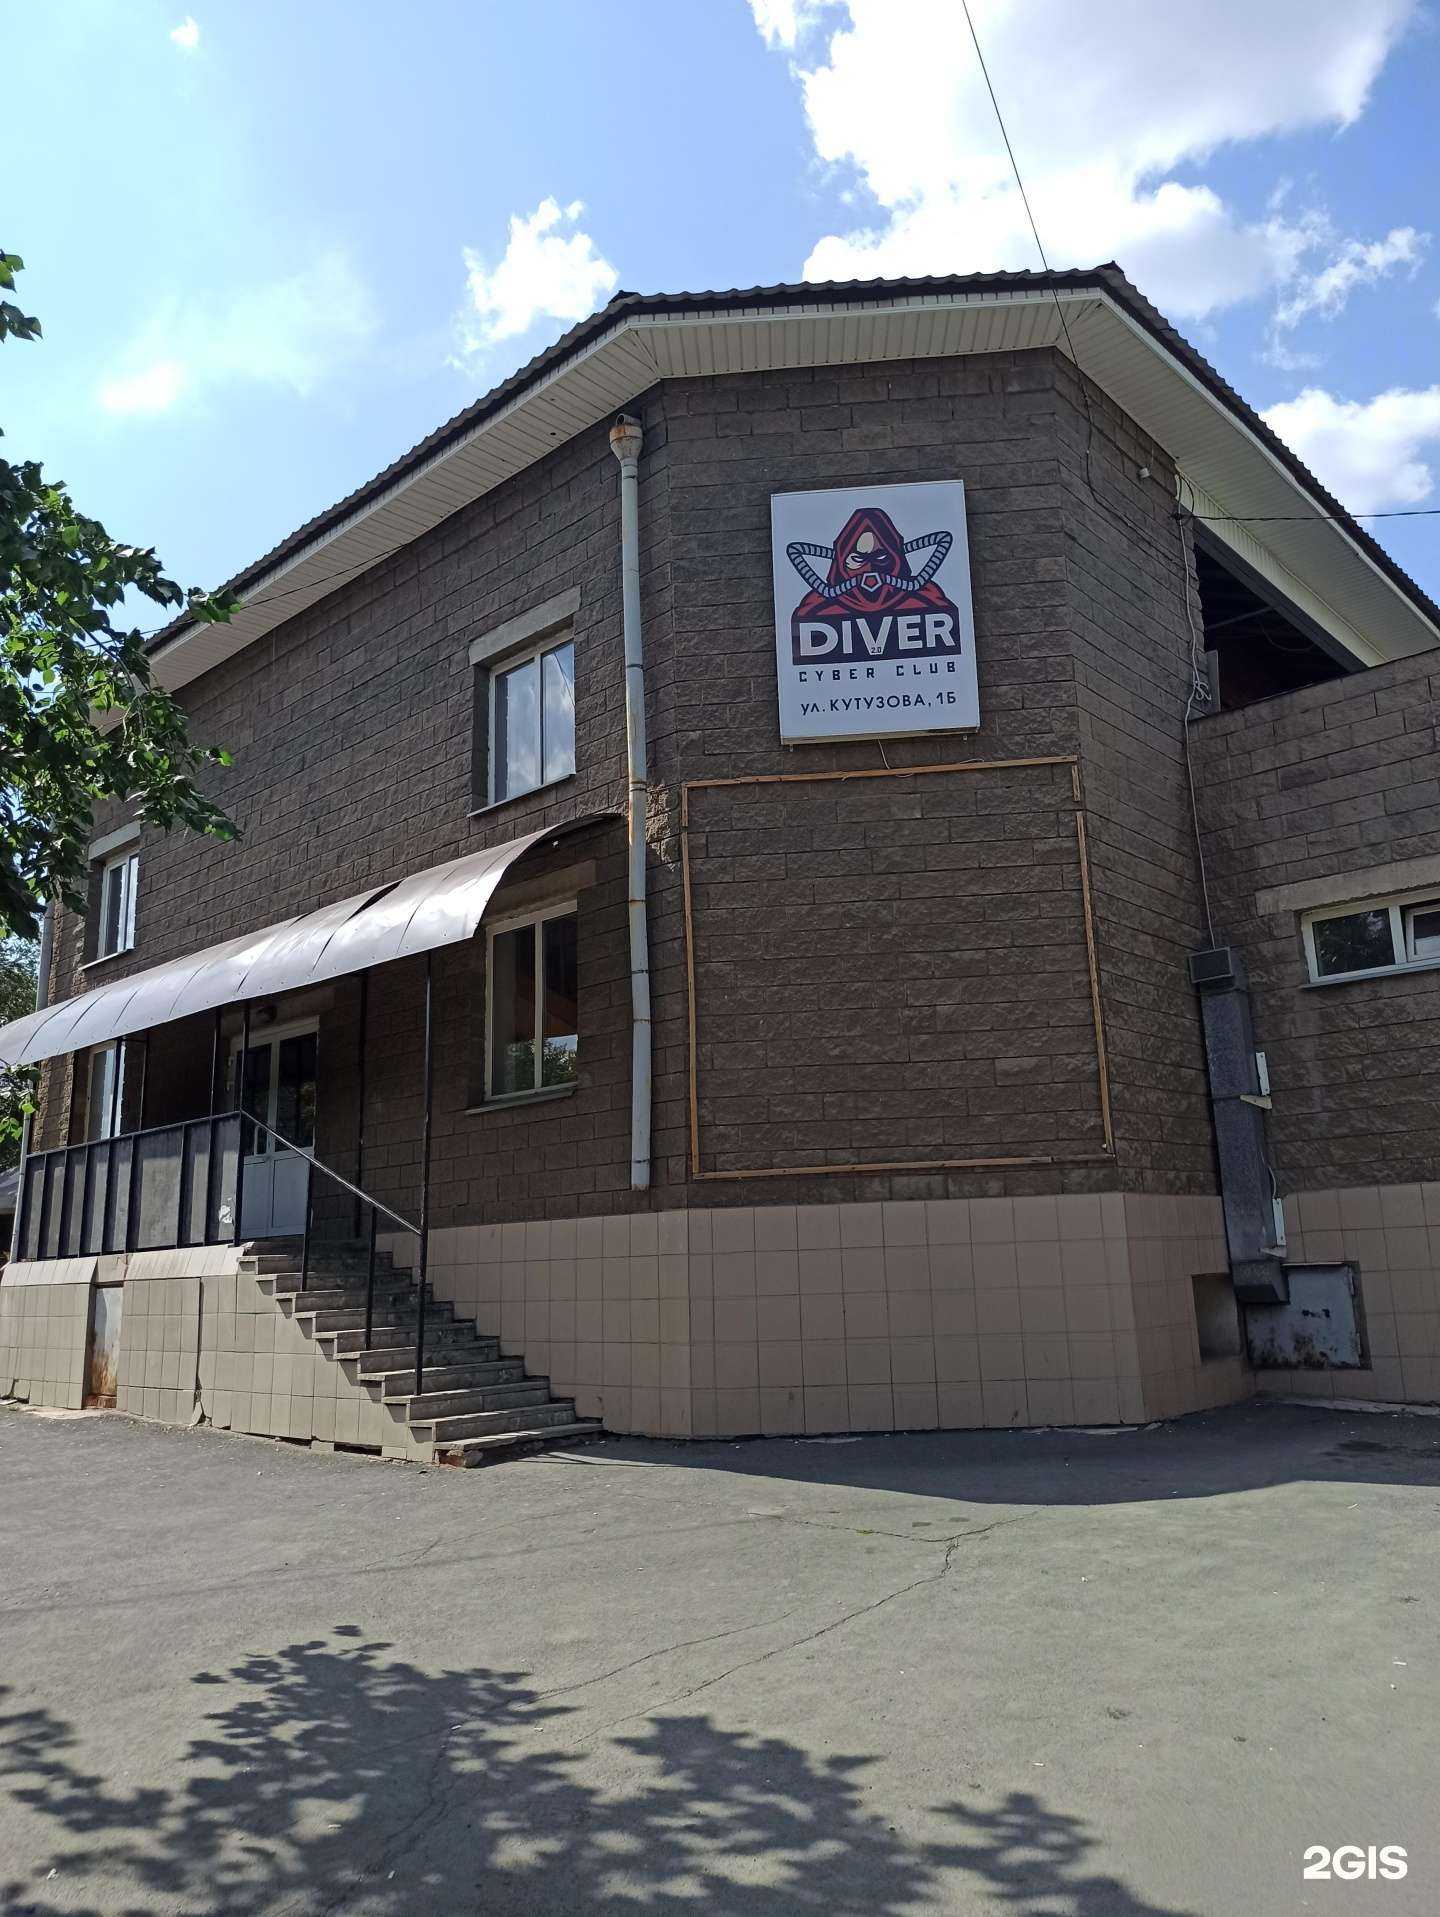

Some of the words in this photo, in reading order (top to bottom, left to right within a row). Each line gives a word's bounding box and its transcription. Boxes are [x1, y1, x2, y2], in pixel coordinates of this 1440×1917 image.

[799, 612, 956, 656] DIVER
[799, 667, 875, 683] CYBER
[896, 661, 956, 677] CLUB
